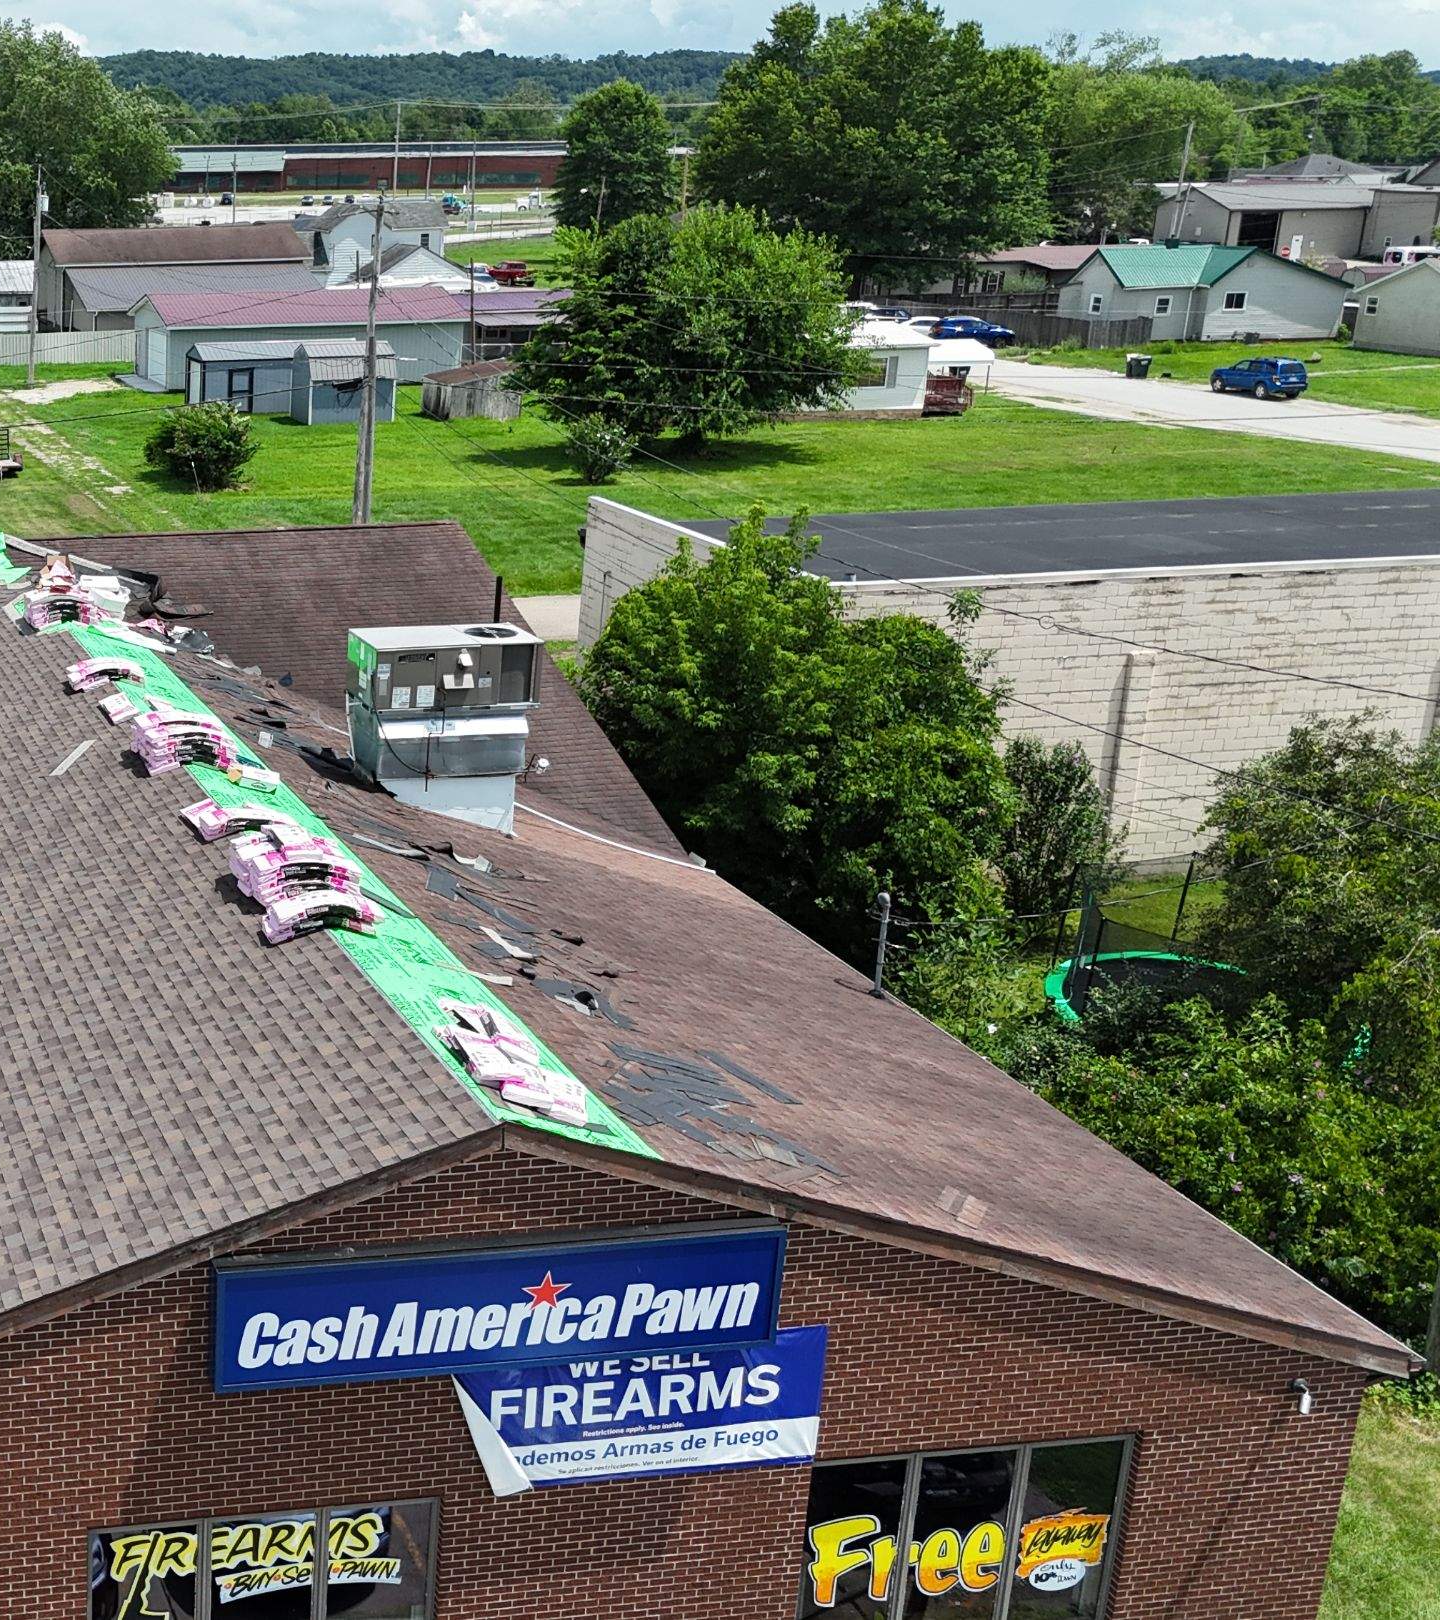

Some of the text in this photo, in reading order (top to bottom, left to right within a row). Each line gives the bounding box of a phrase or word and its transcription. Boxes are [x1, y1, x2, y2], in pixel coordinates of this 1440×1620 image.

[238, 1282, 760, 1369] Cash America Pawn
[569, 1352, 710, 1379] WE SELL
[490, 1364, 780, 1431] FIREARMS
[582, 1421, 685, 1438] Restrictions apply. See inside.
[602, 1441, 674, 1459] Armas
[681, 1434, 707, 1451] de
[713, 1427, 779, 1448] Fuego
[116, 1518, 378, 1577] FIREARMS
[809, 1515, 1006, 1606] Free
[229, 1568, 277, 1598] BUY
[281, 1562, 332, 1585] Se
